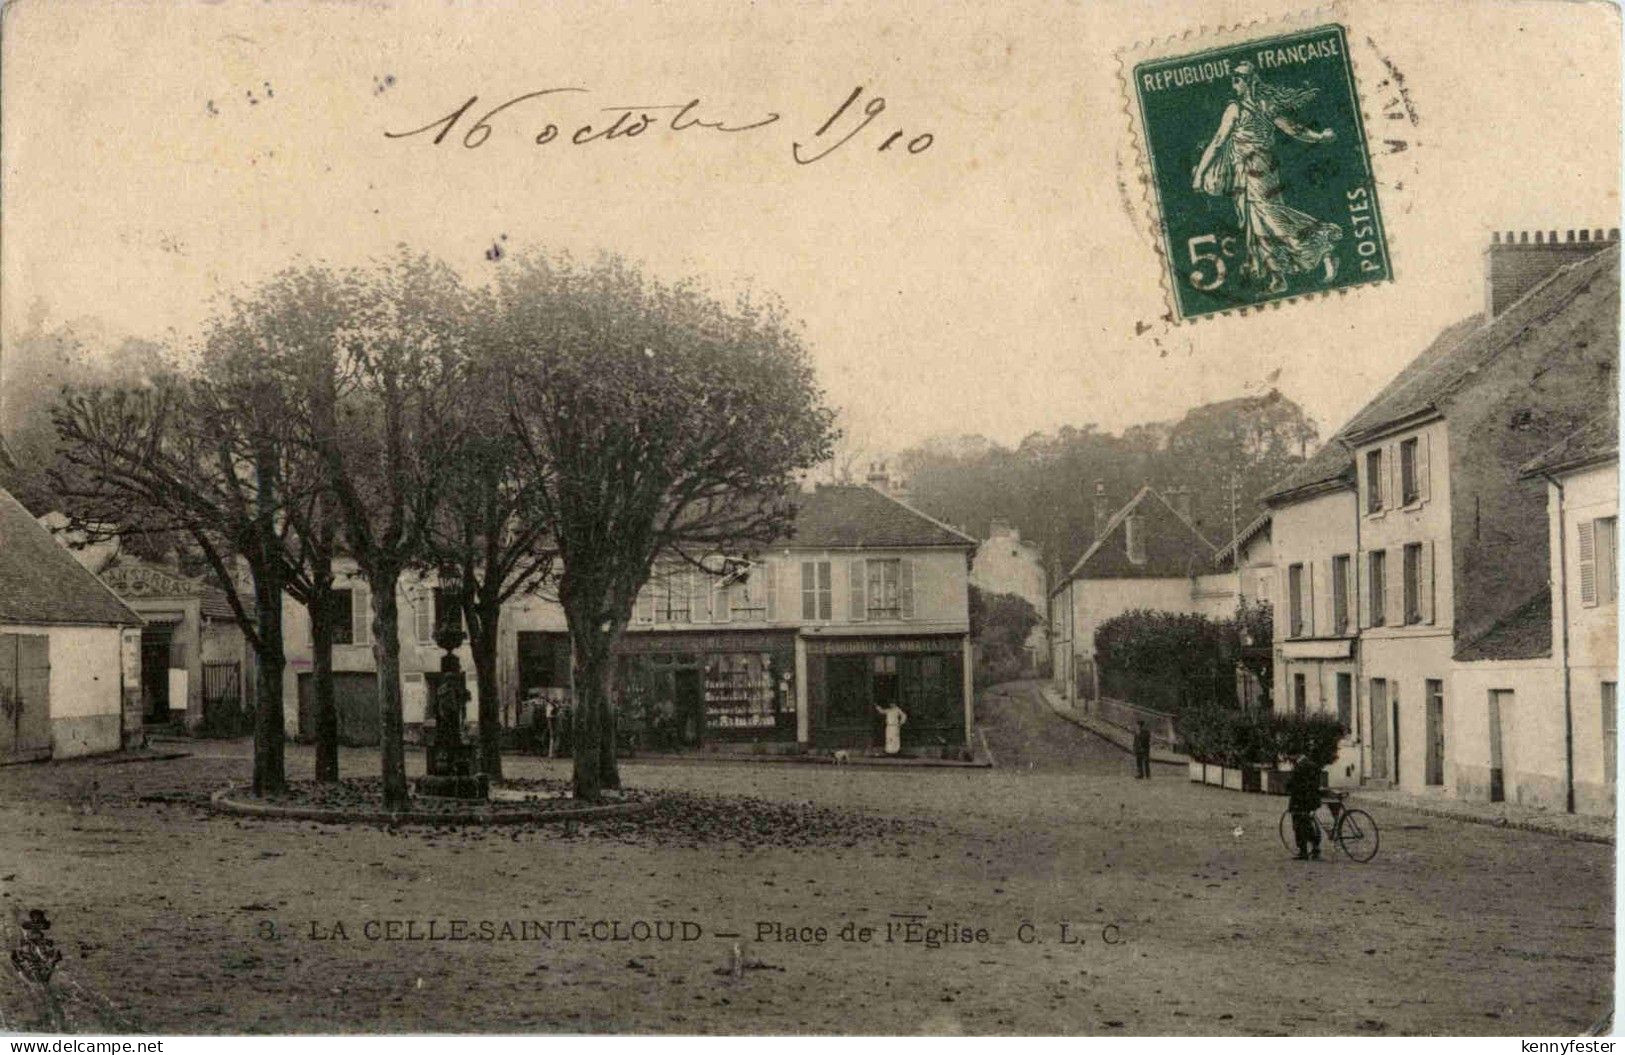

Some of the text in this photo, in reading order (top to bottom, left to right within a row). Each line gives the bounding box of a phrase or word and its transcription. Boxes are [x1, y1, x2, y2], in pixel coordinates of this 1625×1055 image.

[1257, 38, 1339, 69] FRANÇAISE
[384, 88, 589, 148] 16
[792, 87, 935, 164] 1910
[1347, 185, 1382, 274] POSTES
